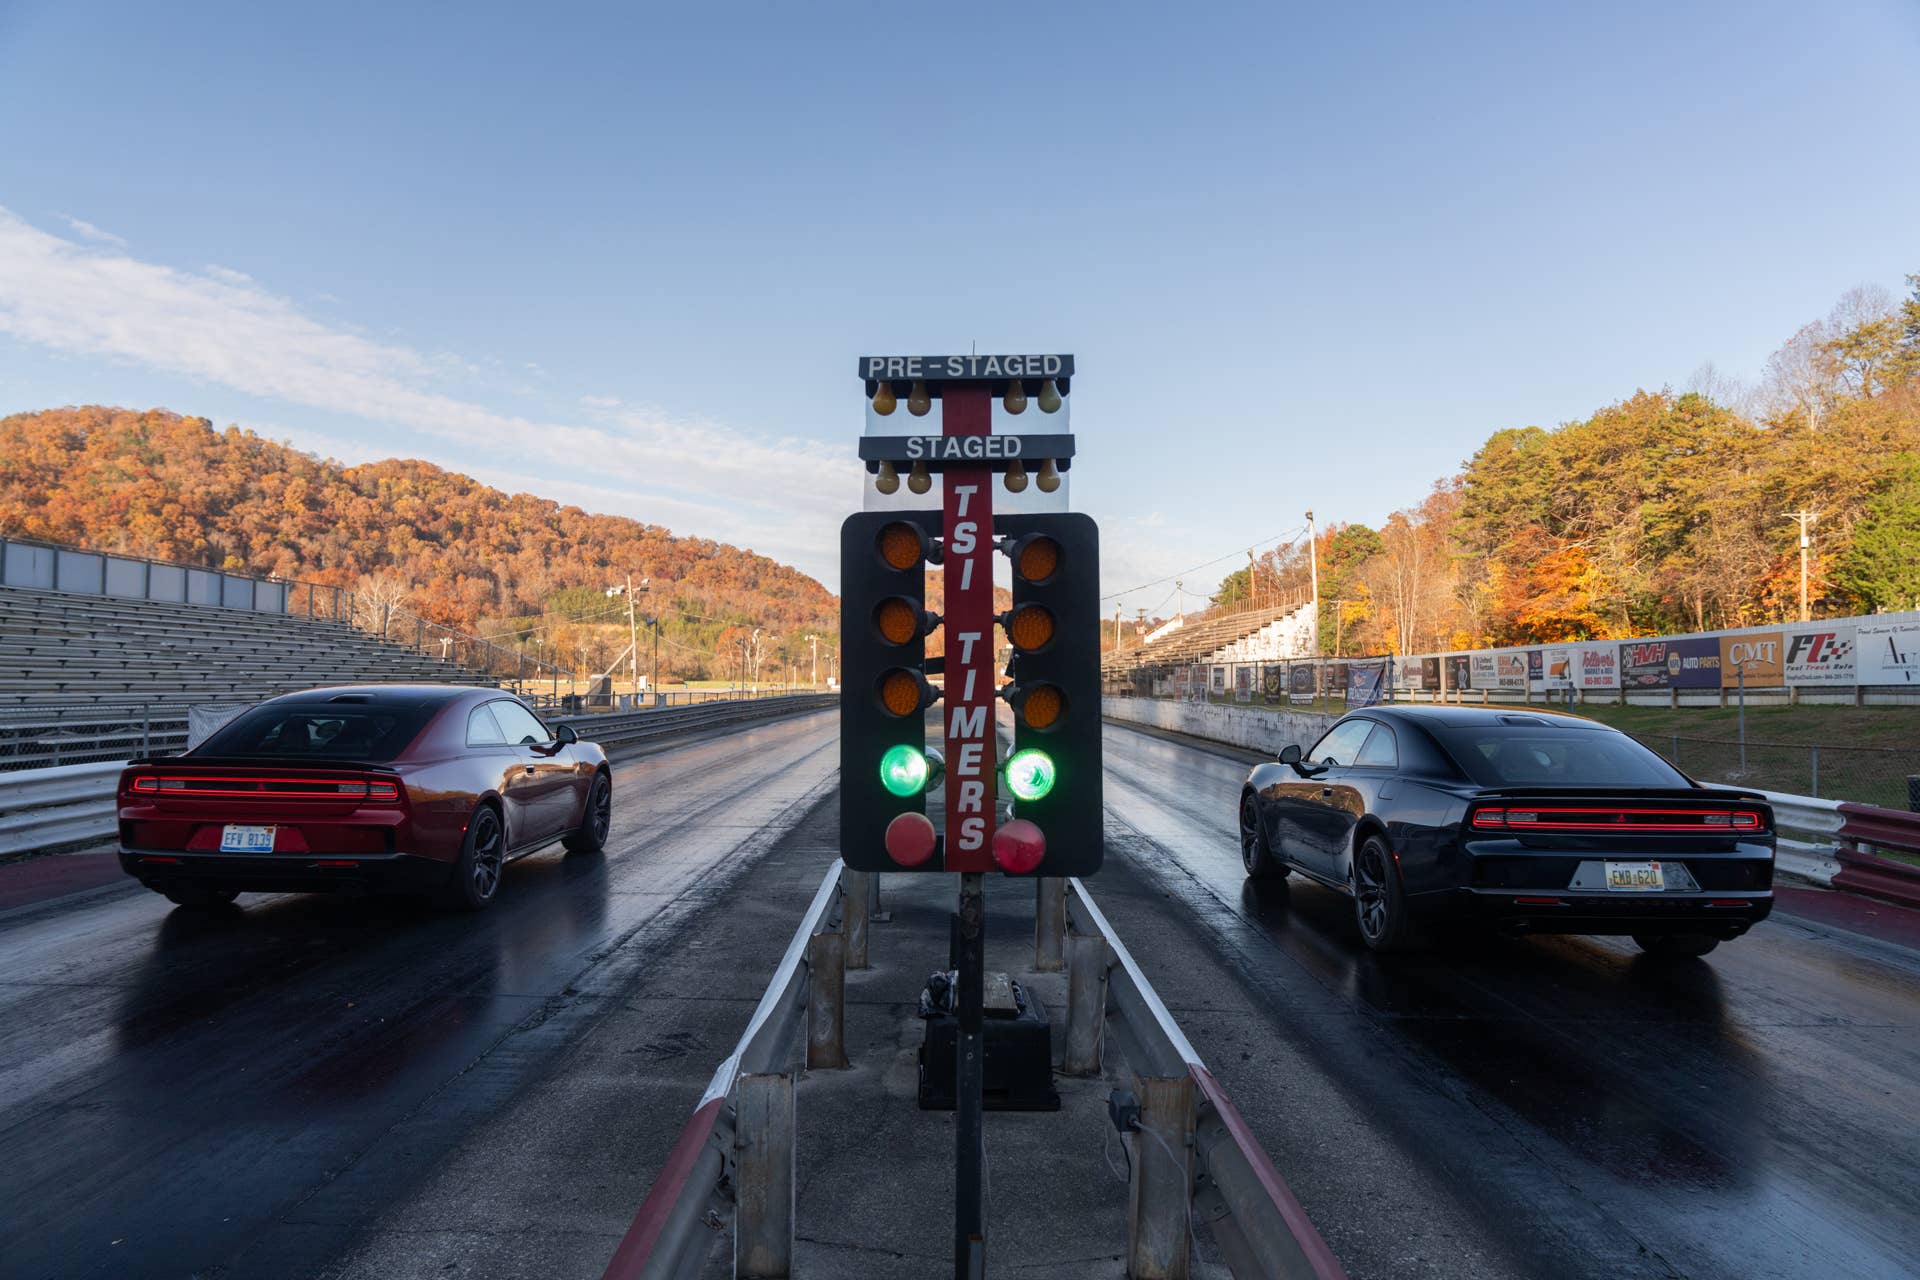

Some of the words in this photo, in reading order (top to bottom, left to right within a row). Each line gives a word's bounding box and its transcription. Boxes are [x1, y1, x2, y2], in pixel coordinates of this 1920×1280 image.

[906, 436, 1022, 458] STAGED
[952, 485, 978, 590] TSI
[1682, 657, 1699, 669] AUTO
[1699, 656, 1720, 669] PARTS
[1729, 641, 1777, 666] CMT
[949, 632, 988, 850] TIMERS
